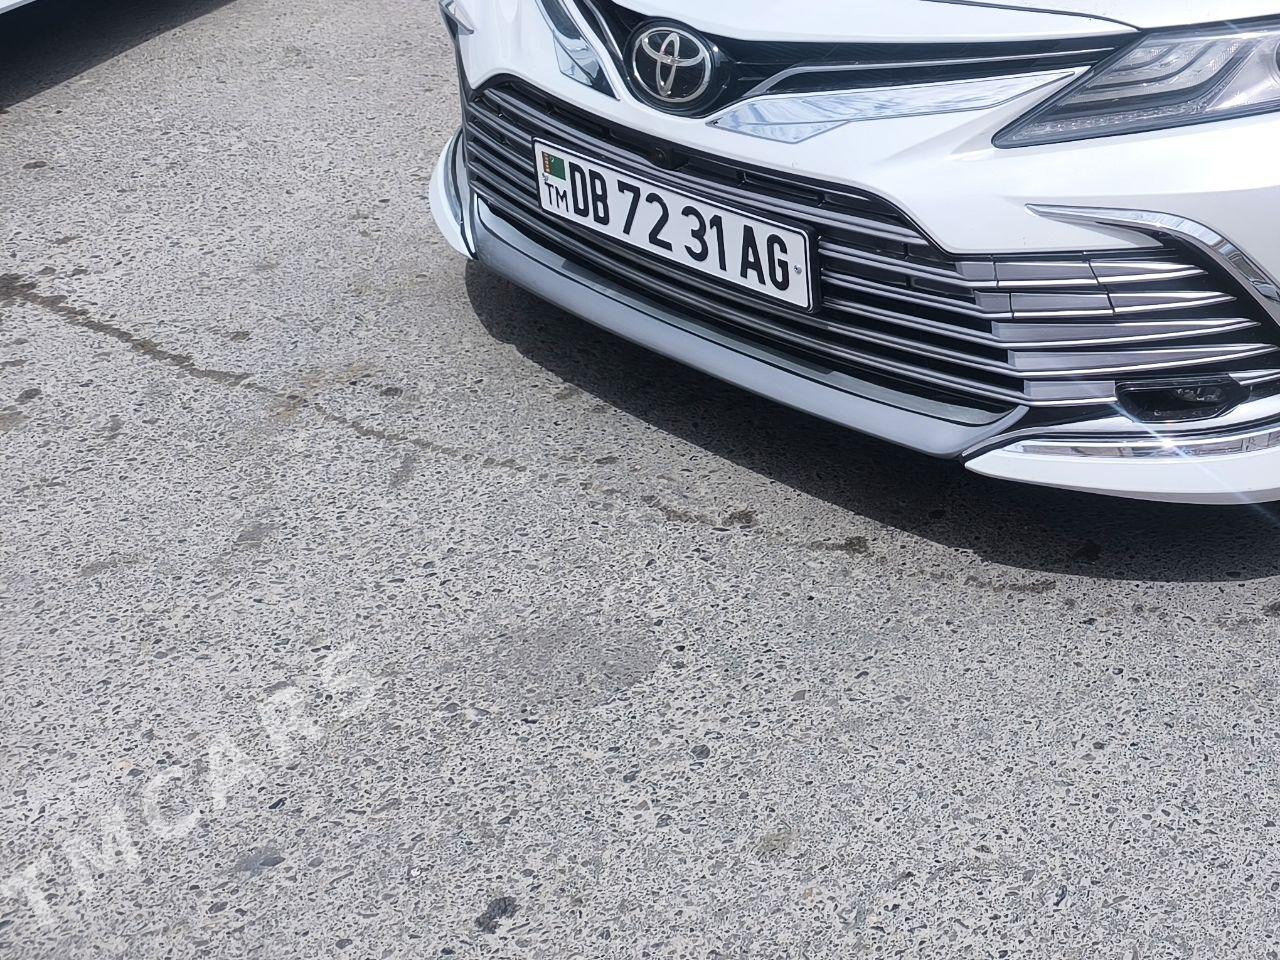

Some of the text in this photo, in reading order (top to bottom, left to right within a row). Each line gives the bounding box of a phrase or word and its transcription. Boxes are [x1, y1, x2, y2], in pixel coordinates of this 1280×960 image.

[544, 180, 569, 213] TM
[568, 161, 610, 226] DB
[739, 224, 790, 291] AG
